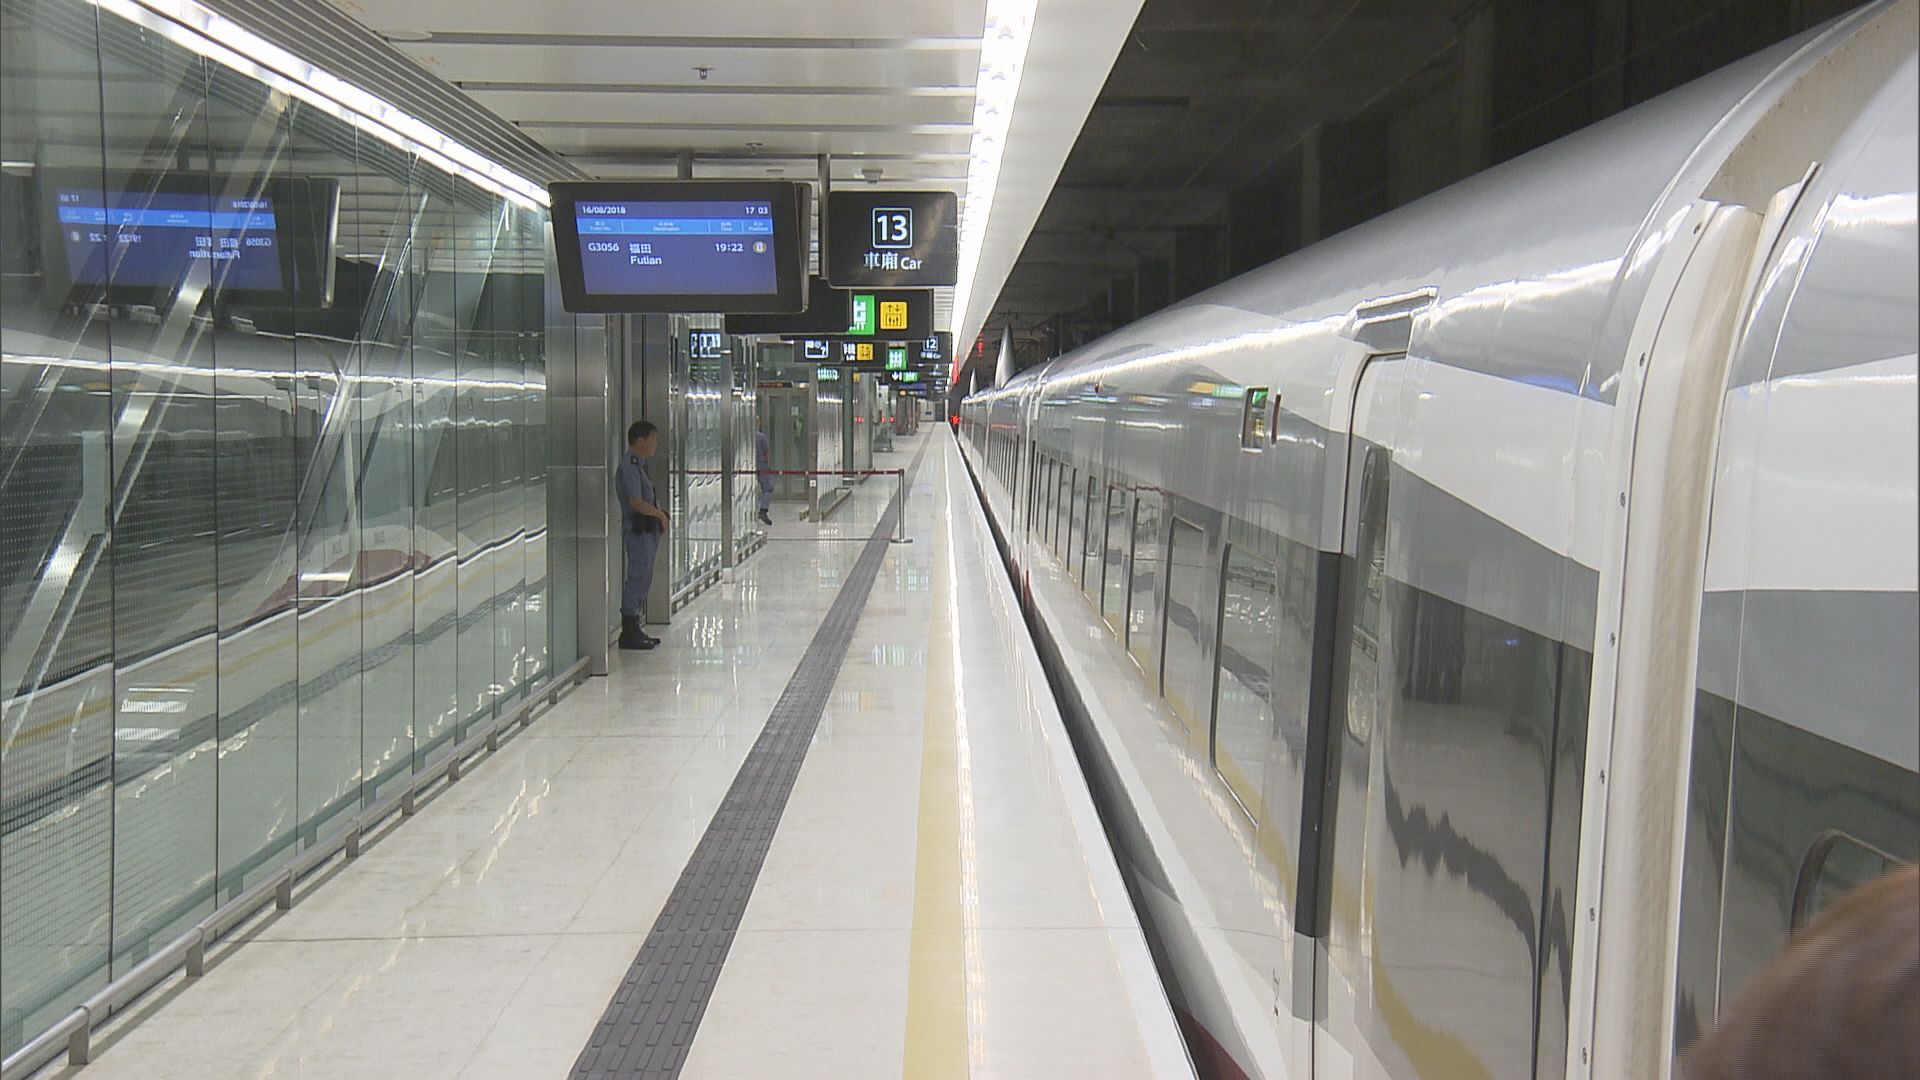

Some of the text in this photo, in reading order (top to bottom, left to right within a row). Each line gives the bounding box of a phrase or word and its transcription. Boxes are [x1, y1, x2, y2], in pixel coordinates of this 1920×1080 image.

[582, 205, 626, 214] 16/08/2018
[877, 214, 908, 241] 13
[587, 242, 620, 252] G3056
[715, 243, 744, 252] 19:22
[630, 255, 663, 265] Futian
[863, 251, 923, 271] 車廂 Car
[925, 340, 937, 349] 12
